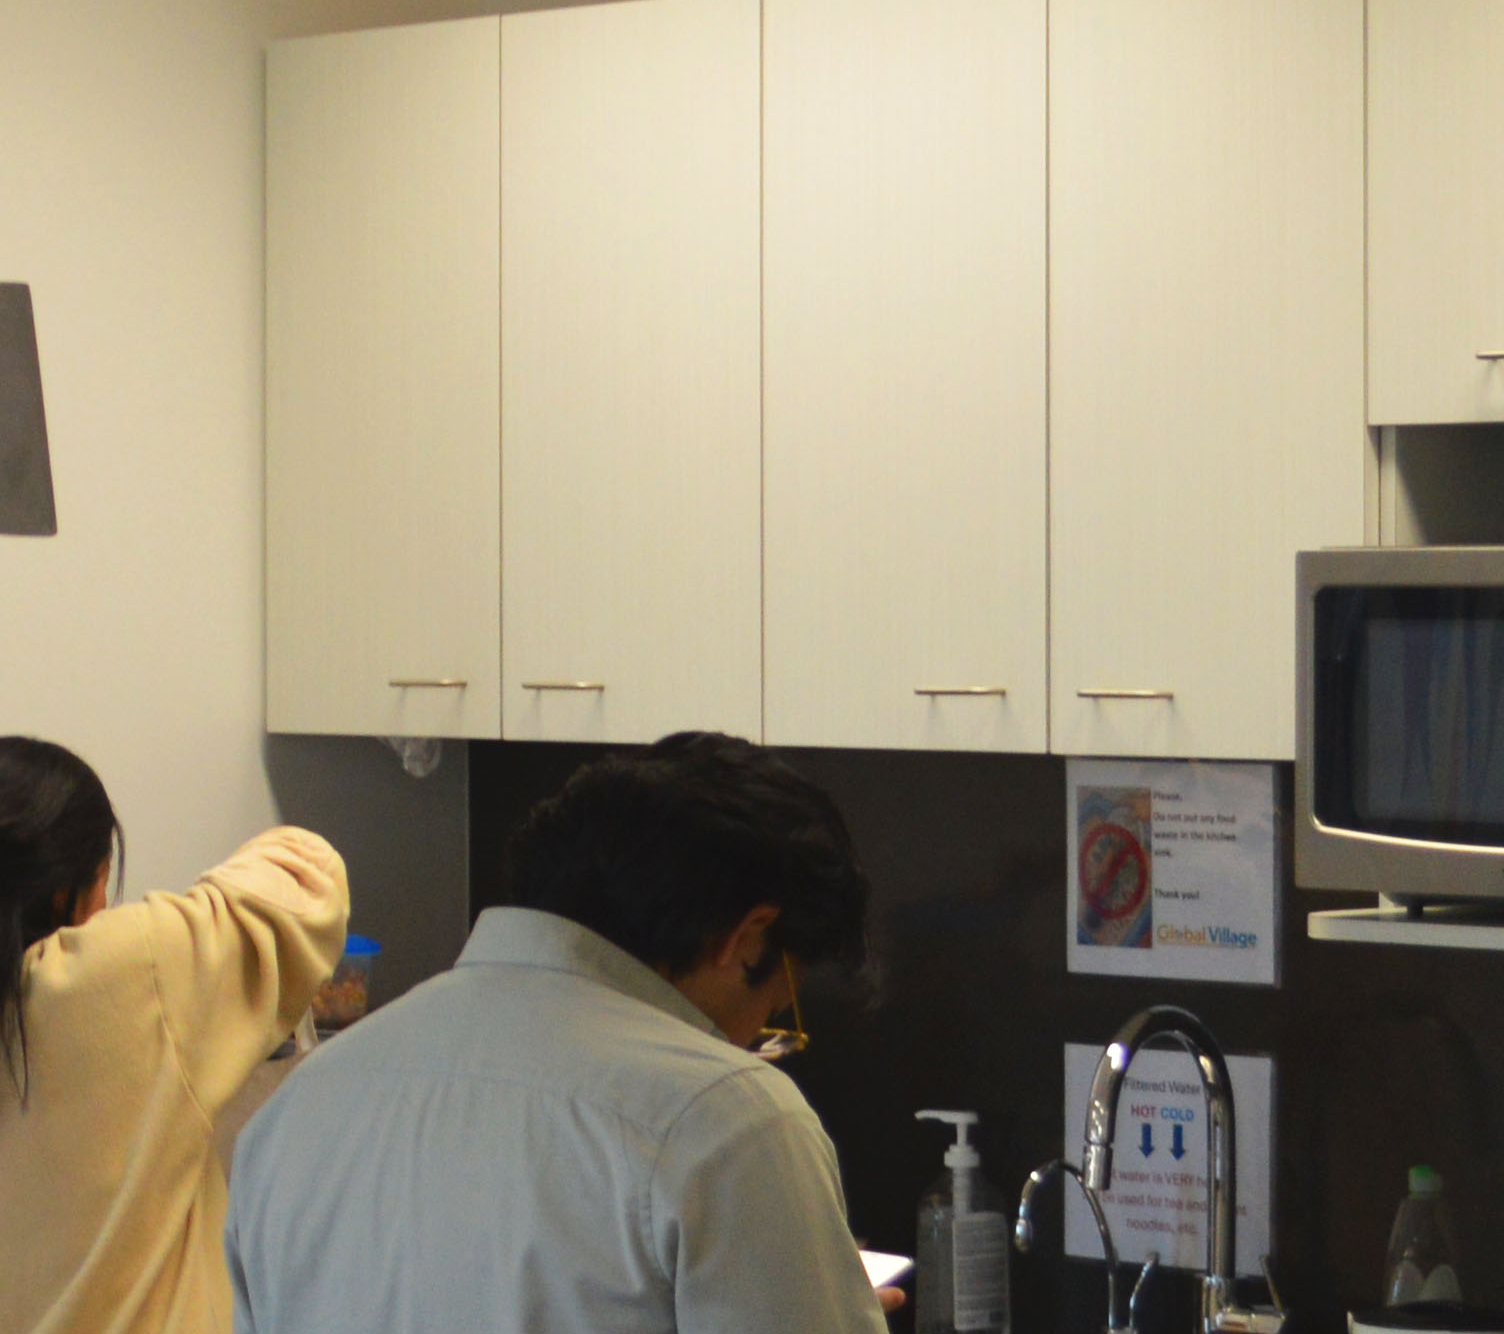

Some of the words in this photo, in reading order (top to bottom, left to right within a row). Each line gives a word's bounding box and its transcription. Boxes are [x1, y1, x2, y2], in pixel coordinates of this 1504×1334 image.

[1153, 812, 1165, 822] Do
[1167, 813, 1181, 822] not
[1154, 832, 1178, 840] waste
[1180, 831, 1189, 840] in
[1190, 831, 1204, 840] the
[1206, 831, 1237, 842] kitchen
[1154, 888, 1179, 899] Thank
[1157, 924, 1206, 943] Global
[1207, 925, 1258, 948] Village
[1124, 1076, 1166, 1092] Filtered
[1167, 1080, 1202, 1096] Water
[1130, 1104, 1157, 1118] HOT
[1160, 1107, 1195, 1122] COLD
[1119, 1170, 1151, 1182] water
[1152, 1172, 1163, 1183] is
[1164, 1173, 1195, 1187] VERY
[1118, 1193, 1145, 1206] used
[1147, 1194, 1162, 1208] for
[1163, 1197, 1184, 1210] tea
[1127, 1217, 1175, 1234] noodles,
